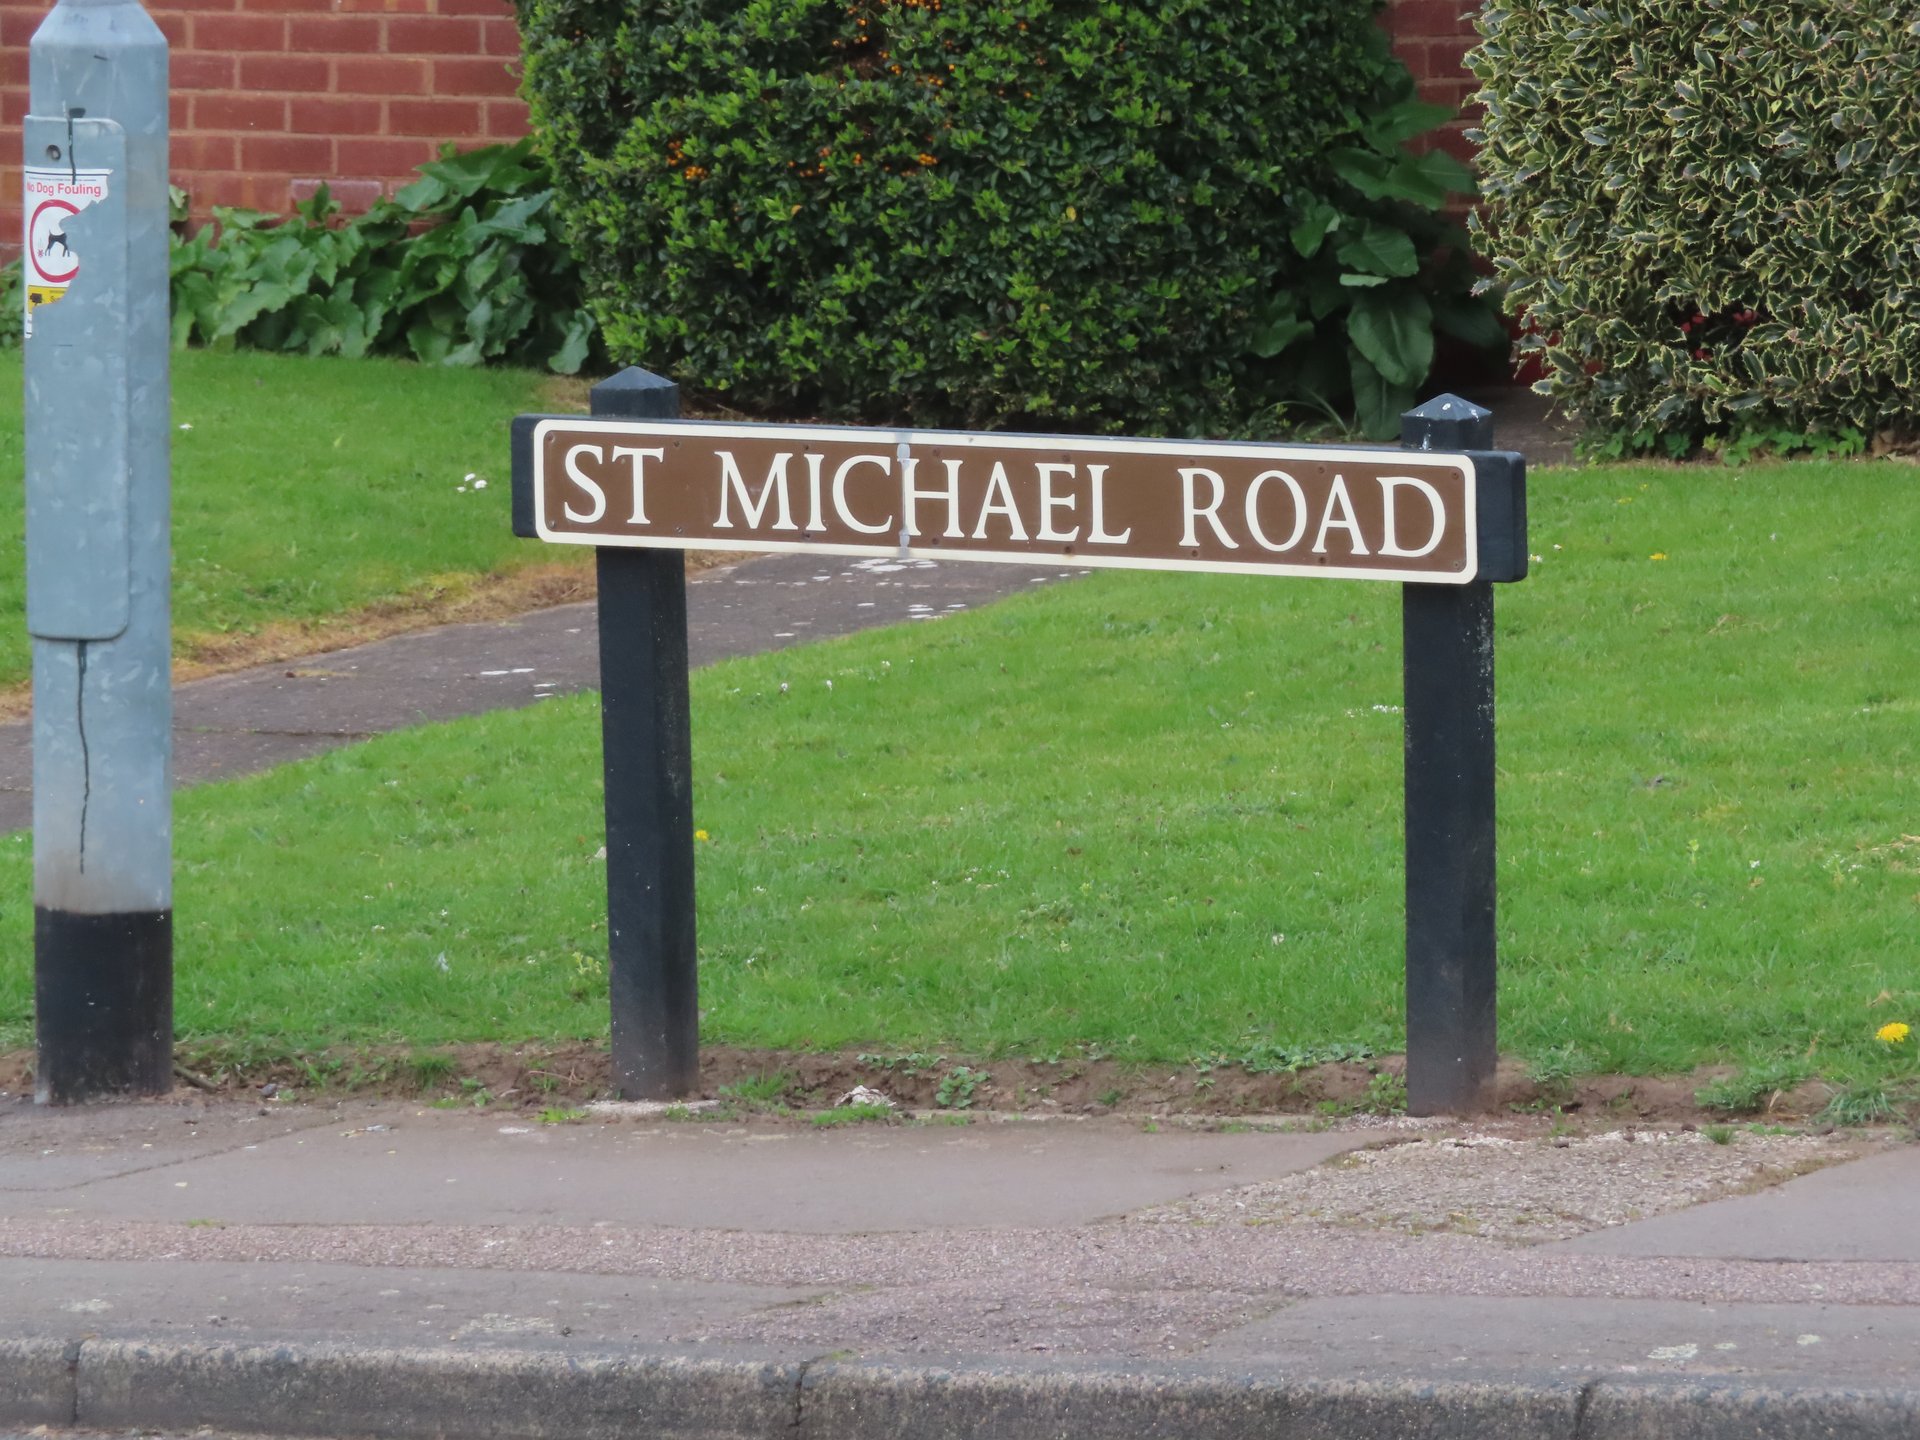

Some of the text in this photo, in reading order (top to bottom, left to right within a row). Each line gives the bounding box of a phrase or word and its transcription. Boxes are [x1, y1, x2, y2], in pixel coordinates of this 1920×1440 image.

[36, 182, 54, 196] Dog
[57, 183, 101, 197] Fouling
[564, 444, 1446, 557] ST MICHAEL ROAD
